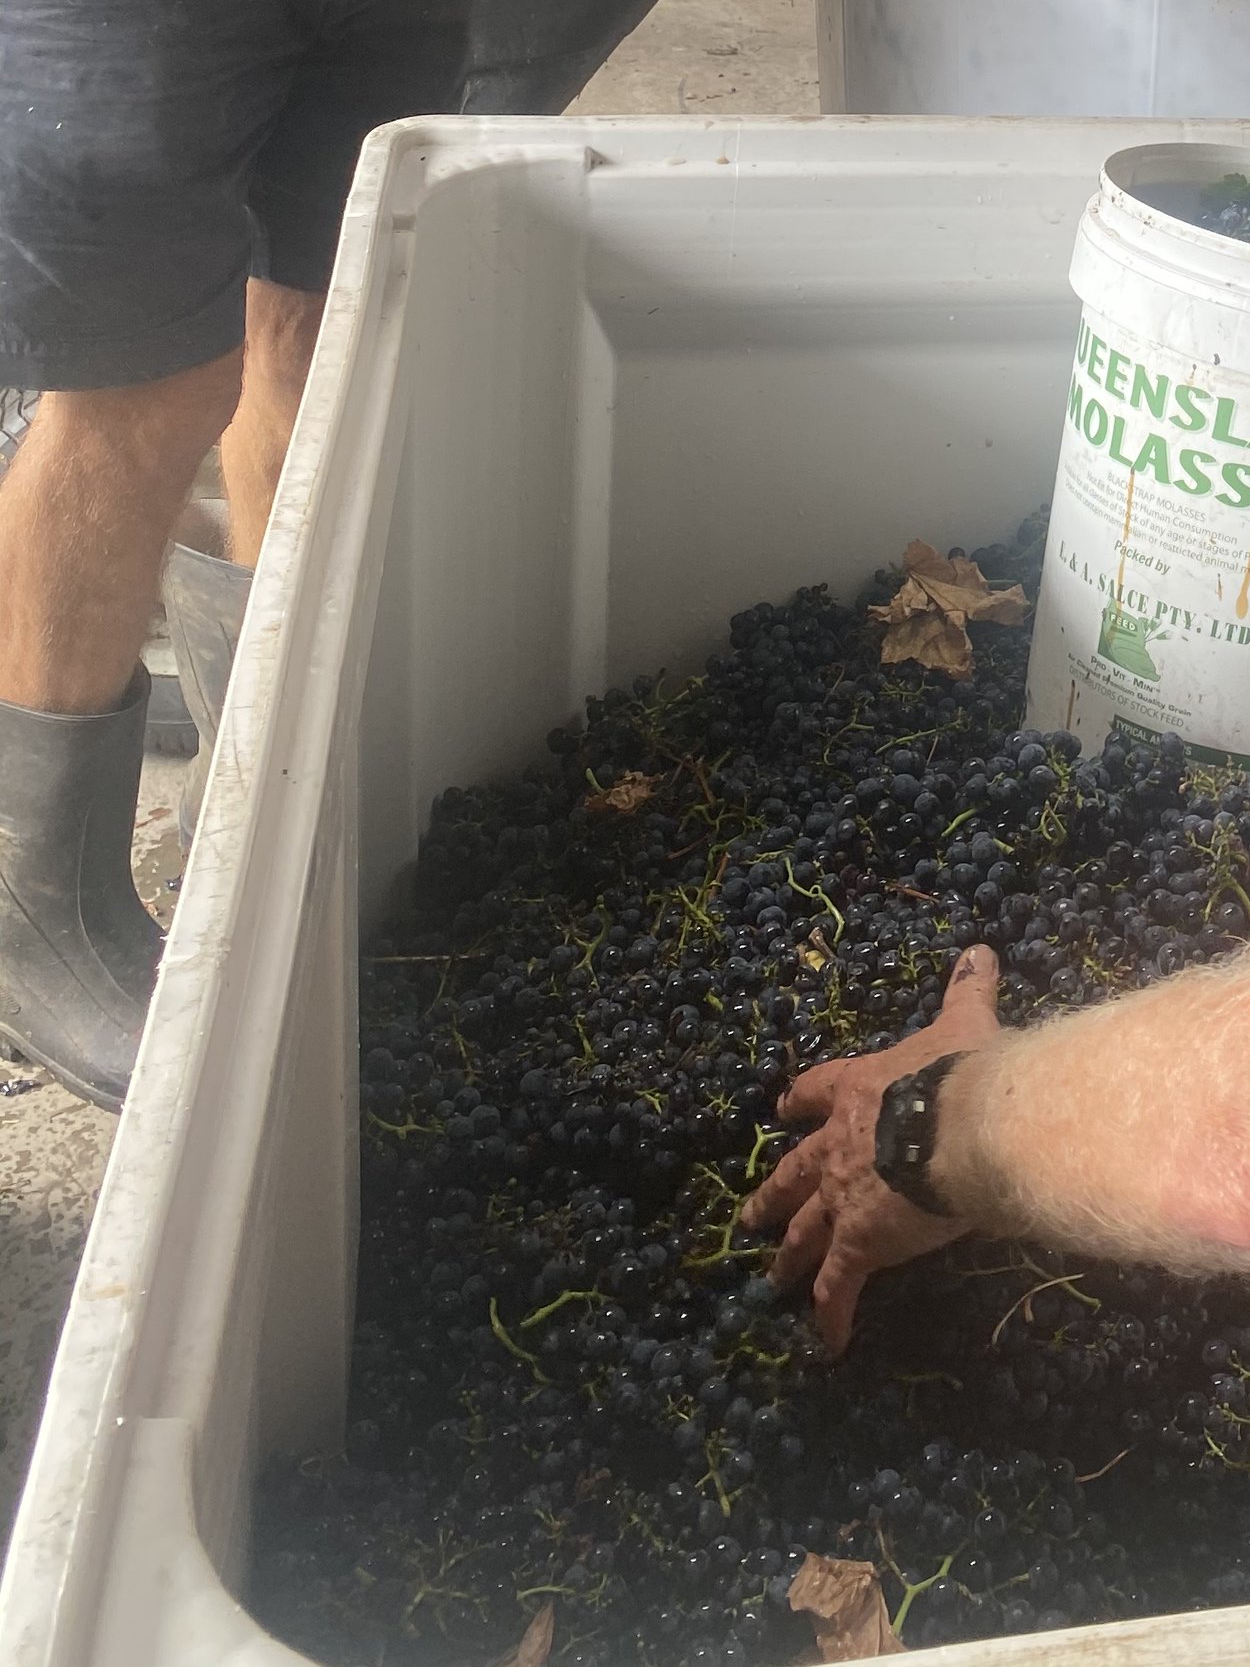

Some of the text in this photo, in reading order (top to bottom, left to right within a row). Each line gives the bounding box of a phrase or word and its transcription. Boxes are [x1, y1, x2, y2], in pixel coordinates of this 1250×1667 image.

[1107, 471, 1206, 522] BLACTRAP MOLASSES
[1116, 491, 1138, 510] Dirct
[1140, 502, 1170, 524] Human
[1172, 516, 1237, 545] Consumption
[1118, 504, 1138, 524] Stck
[1140, 518, 1150, 527] of
[1150, 524, 1166, 537] any
[1167, 530, 1184, 543] age
[1199, 540, 1229, 556] stages
[1232, 550, 1243, 559] of
[1114, 540, 1171, 576] Packed by
[1205, 555, 1239, 571] animal
[1097, 573, 1149, 614] SALCE
[1155, 600, 1202, 633] PTY.
[1109, 614, 1137, 631] FEED
[1069, 665, 1116, 701] DISTIBUTORS
[1117, 695, 1130, 707] OF
[1130, 700, 1159, 719] STOCK
[1160, 713, 1184, 727] FEED
[1137, 692, 1166, 709] Quality
[1169, 704, 1192, 717] Grain
[1115, 719, 1148, 742] TYPICAL
